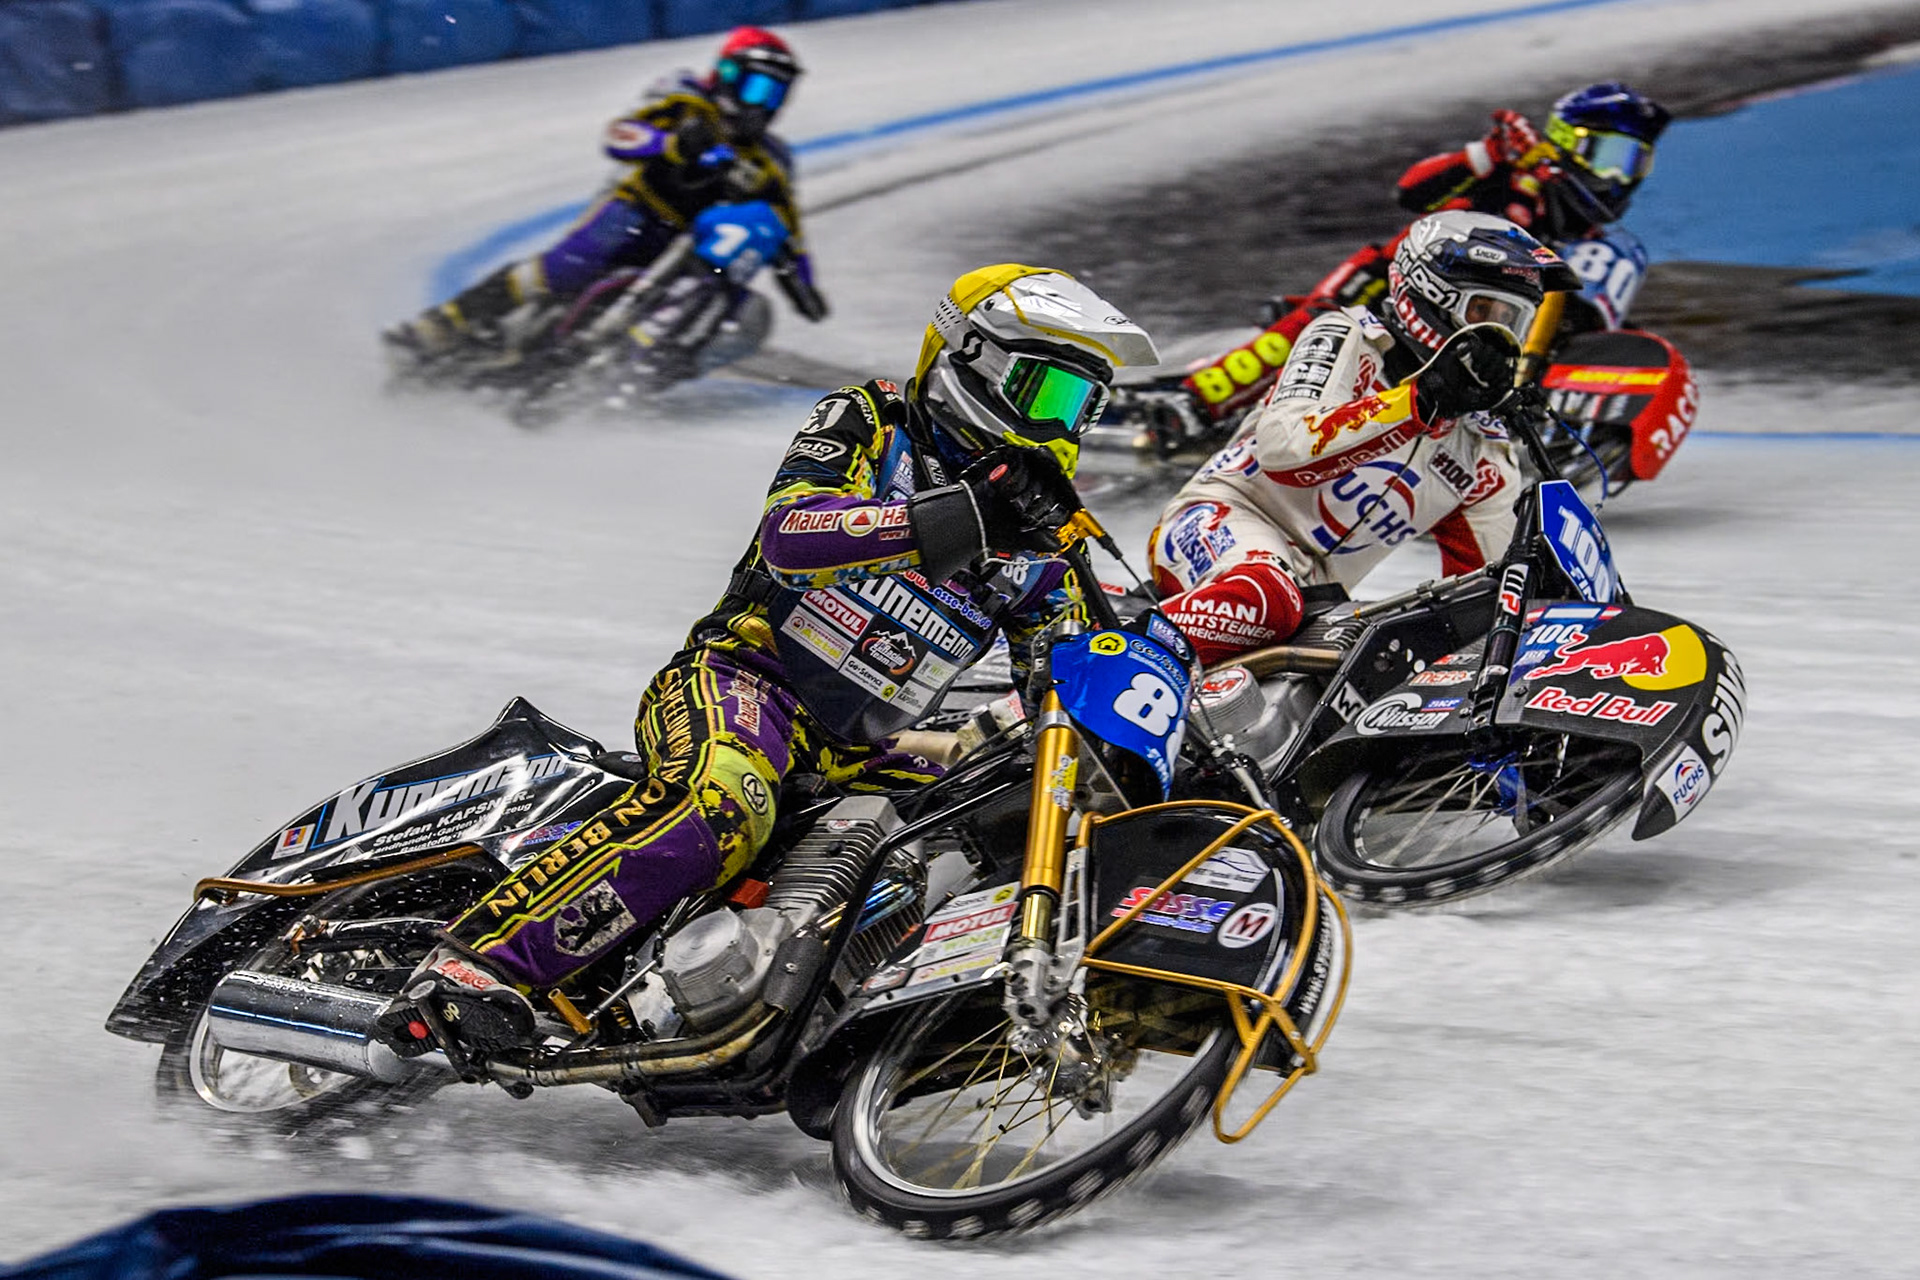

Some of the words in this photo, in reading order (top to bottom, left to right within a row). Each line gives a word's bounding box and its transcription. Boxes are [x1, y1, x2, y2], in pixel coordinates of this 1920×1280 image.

[1430, 450, 1474, 492] #100
[781, 511, 843, 532] Mauer
[1331, 470, 1418, 546] UCHS
[807, 590, 865, 632] MOTUL
[1190, 599, 1258, 623] MAN
[1527, 687, 1609, 715] Red
[1596, 697, 1673, 726] Bull
[1672, 764, 1705, 806] FUCHS
[372, 822, 433, 848] Stefan
[487, 820, 613, 918] BERLIN
[931, 908, 1008, 939] MOTUL
